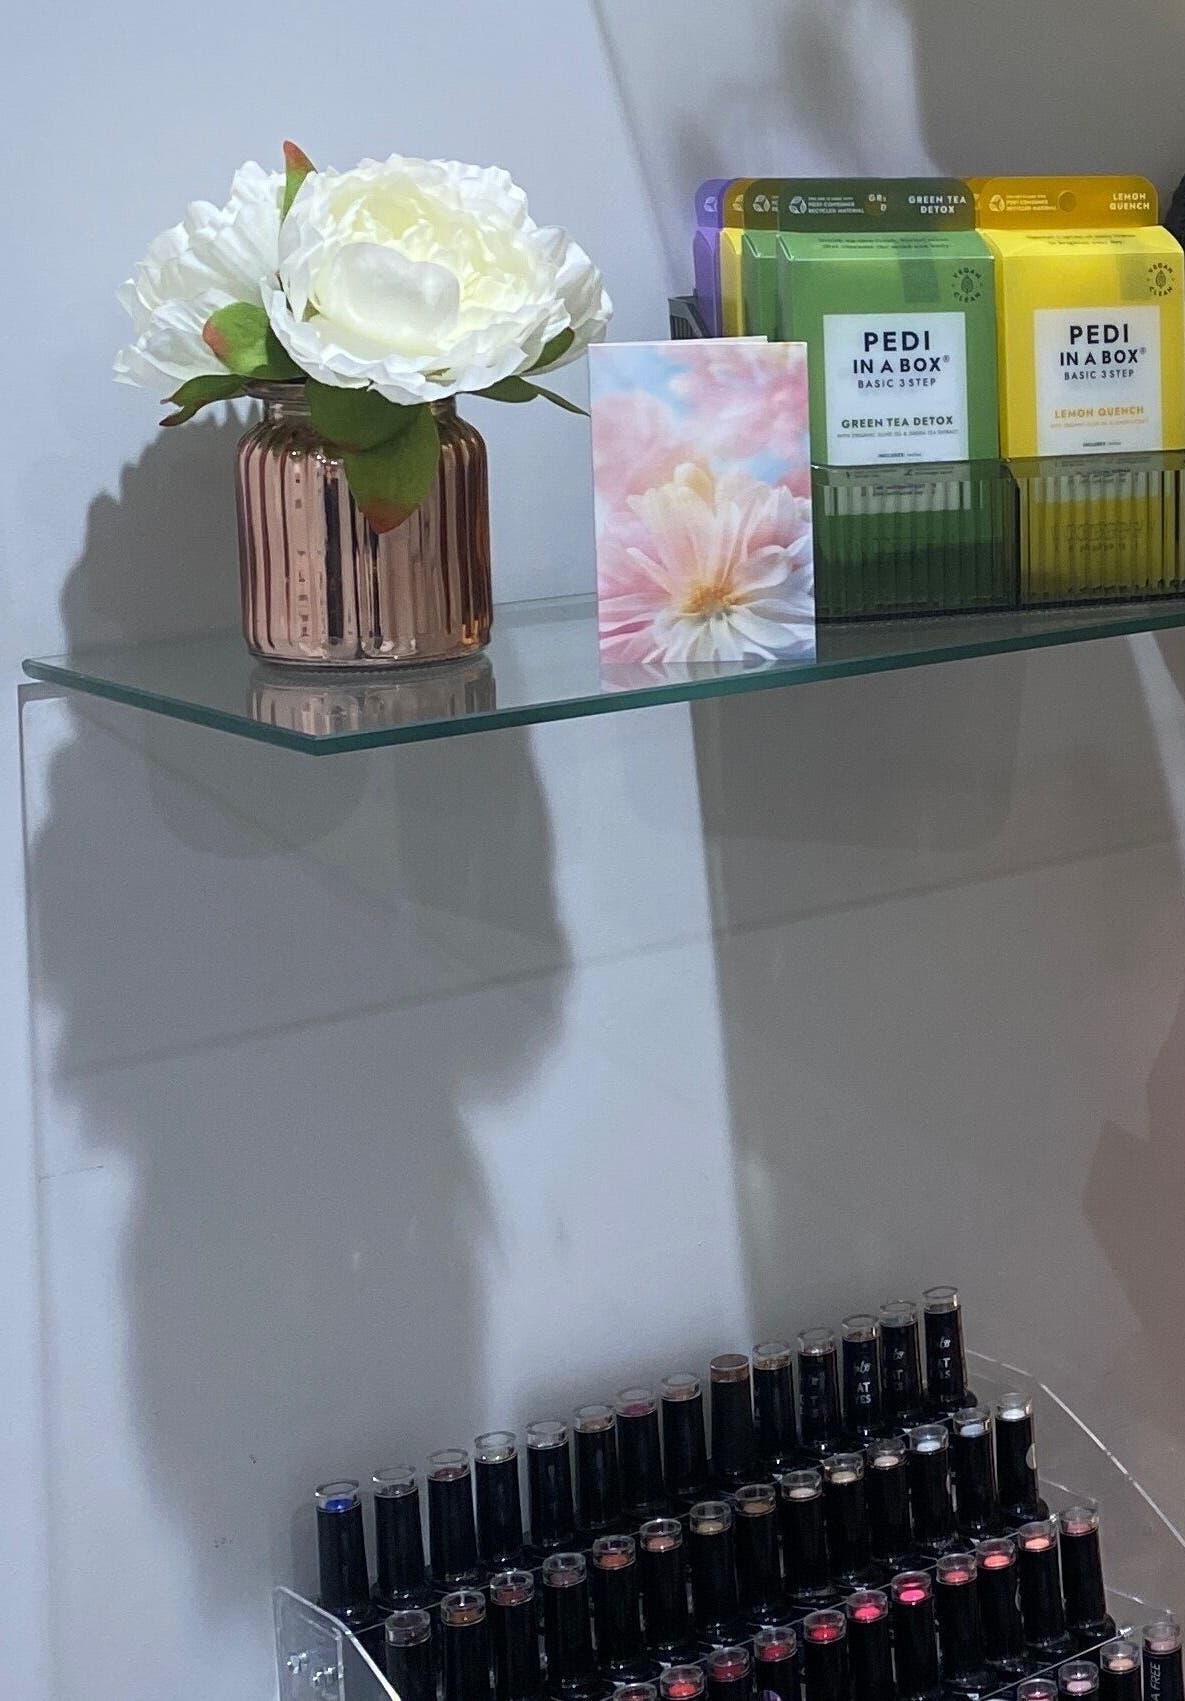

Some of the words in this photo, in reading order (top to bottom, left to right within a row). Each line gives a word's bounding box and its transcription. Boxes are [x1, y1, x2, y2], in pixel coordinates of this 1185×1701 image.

[908, 195, 943, 204] GREEN
[944, 195, 967, 204] TEA
[1112, 192, 1146, 201] LEMON
[920, 205, 955, 214] DETOX
[1109, 202, 1151, 211] QUENCH
[1070, 323, 1128, 345] PEDI
[864, 330, 930, 352] PEDI
[1060, 351, 1078, 366] IN
[1084, 352, 1097, 365] A
[853, 359, 873, 374] IN
[880, 359, 893, 373] A
[1064, 371, 1097, 381] BASIC
[858, 379, 894, 389] BASIC
[1054, 408, 1094, 419] LEMON
[1098, 406, 1144, 417] QUENCH
[841, 418, 883, 429] GREEN
[886, 418, 909, 427] TEA
[913, 416, 953, 426] DETOX
[1150, 1661, 1161, 1691] FREE
